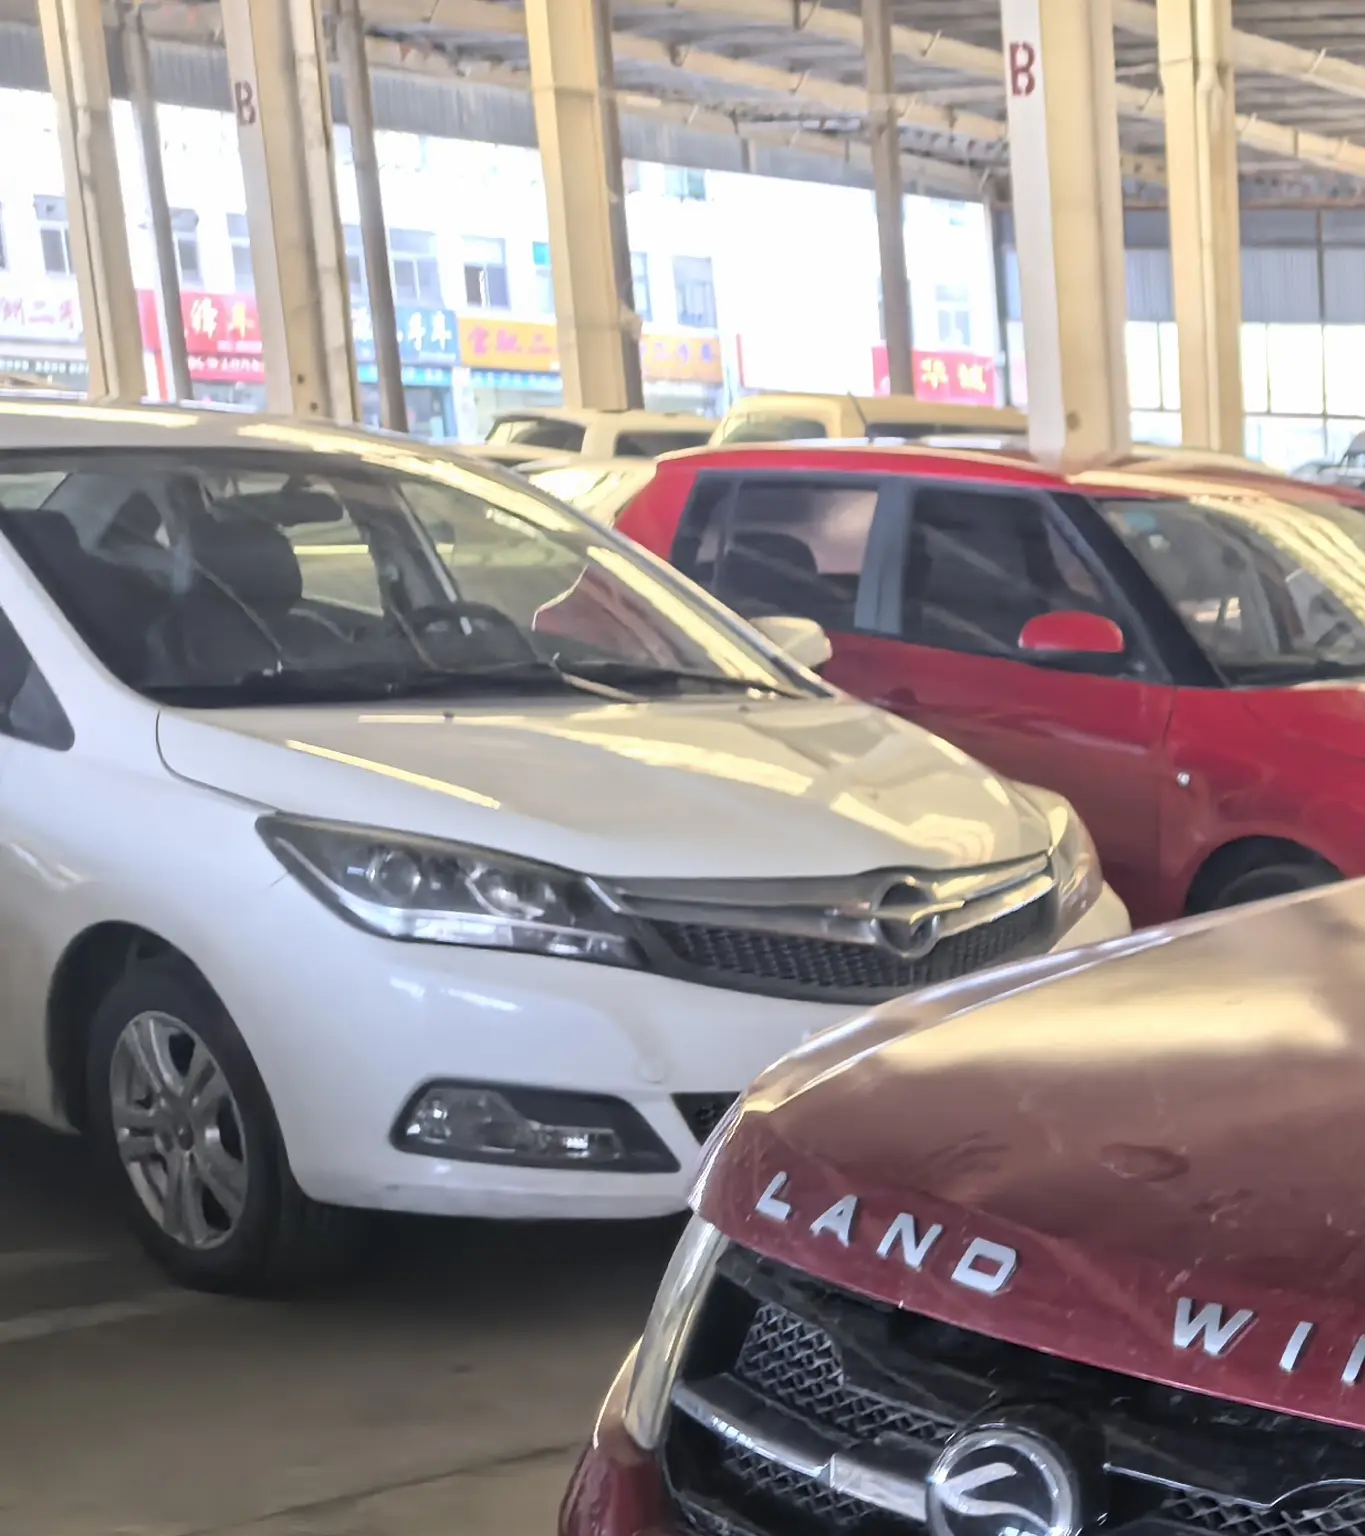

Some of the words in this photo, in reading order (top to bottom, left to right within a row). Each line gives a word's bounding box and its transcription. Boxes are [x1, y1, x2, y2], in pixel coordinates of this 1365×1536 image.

[1009, 41, 1036, 97] B
[234, 80, 256, 126] B
[755, 1170, 1018, 1297] LAND
